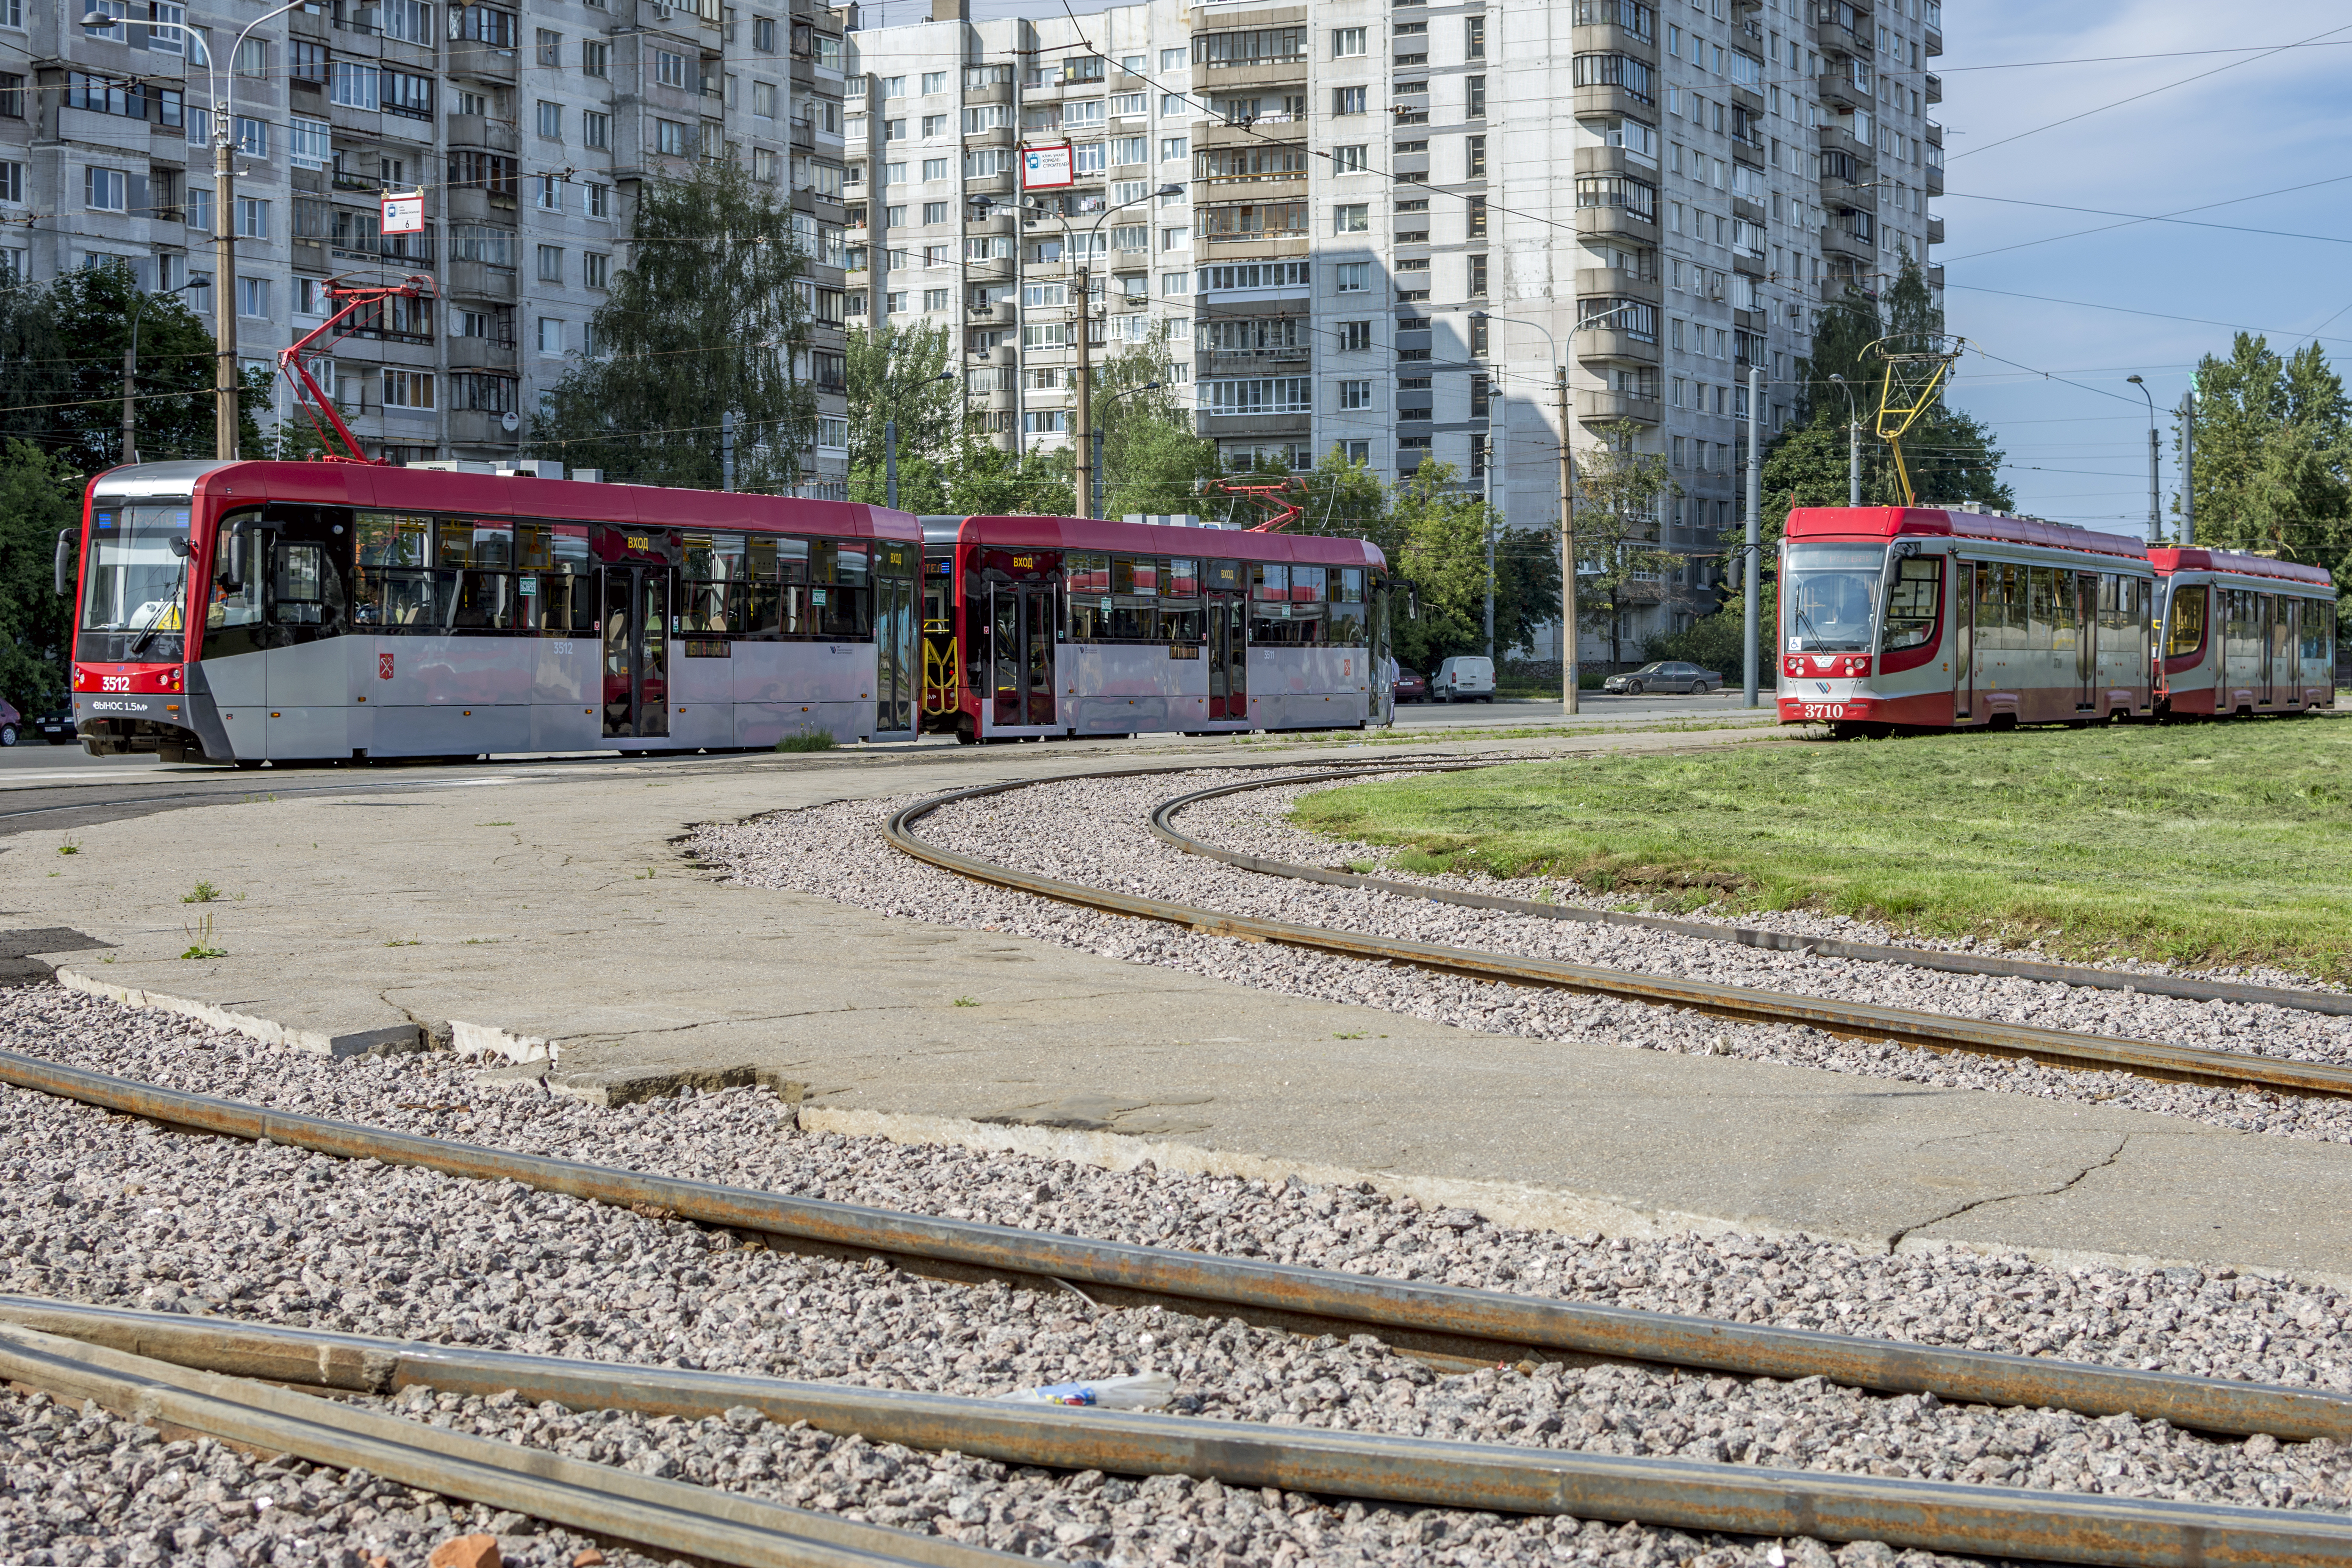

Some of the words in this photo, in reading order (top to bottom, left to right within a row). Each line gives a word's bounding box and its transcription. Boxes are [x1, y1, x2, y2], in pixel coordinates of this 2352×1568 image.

[405, 220, 409, 229] 6
[628, 537, 648, 551] ВХОД
[890, 553, 901, 566] ВХОД
[1014, 557, 1033, 569] ВХОД
[1221, 570, 1233, 580] ВХОД
[554, 642, 573, 654] 3512
[1264, 650, 1274, 659] 3511
[103, 676, 130, 691] 3512
[94, 701, 123, 710] ВЫНОС
[1805, 704, 1843, 718] 3710
